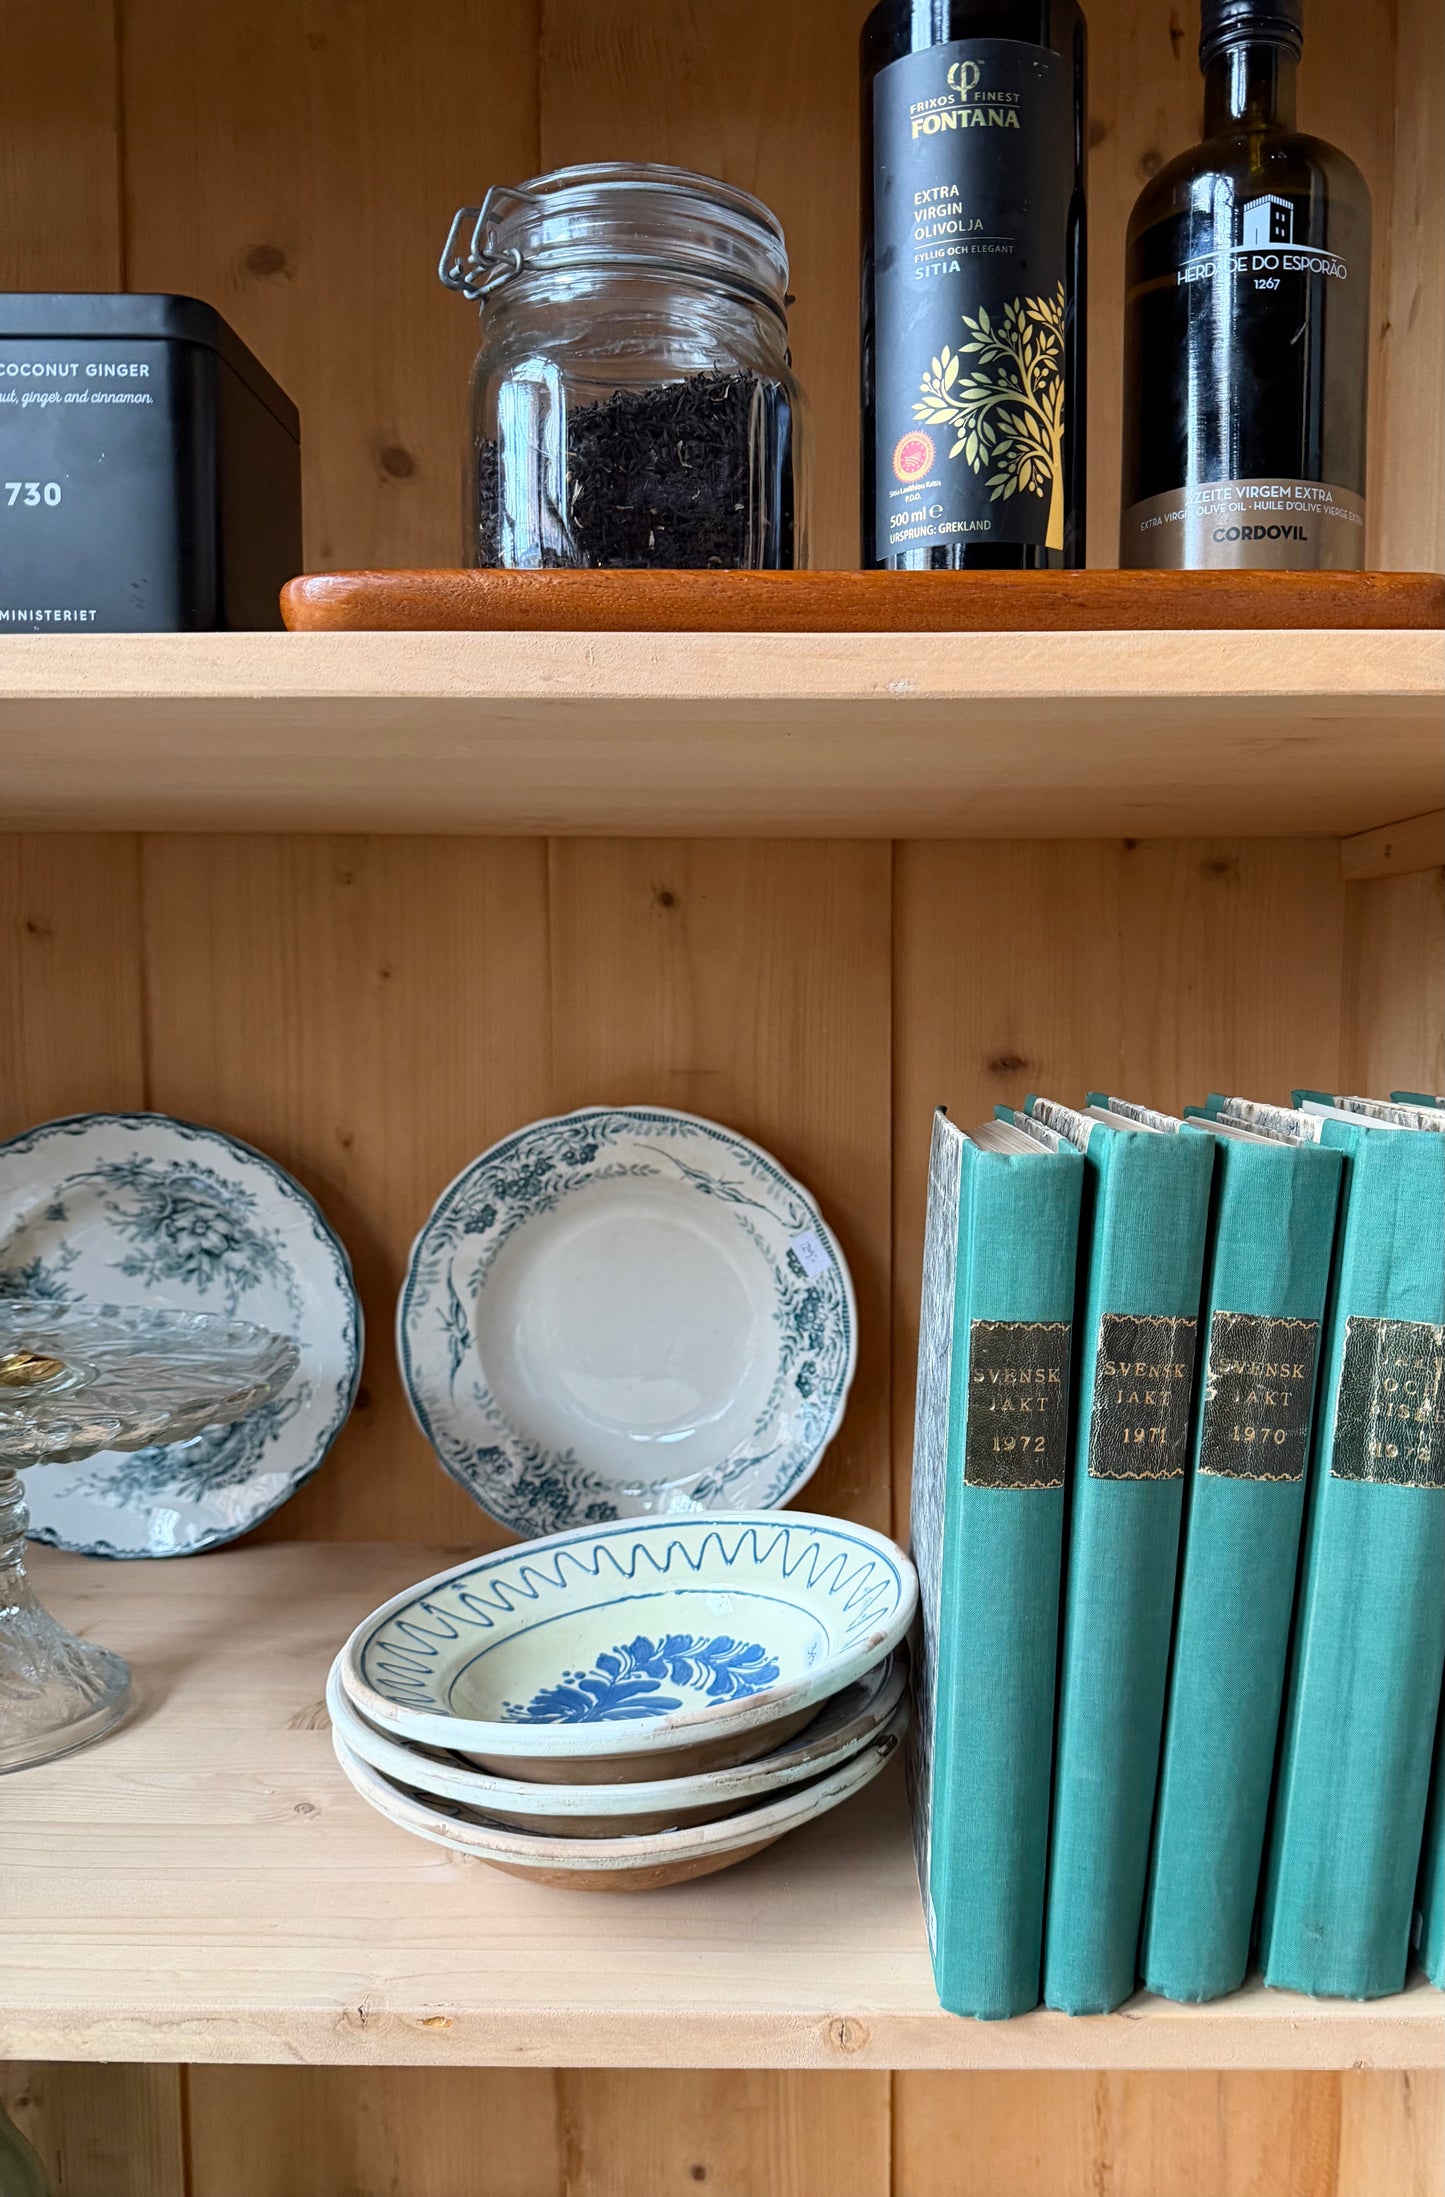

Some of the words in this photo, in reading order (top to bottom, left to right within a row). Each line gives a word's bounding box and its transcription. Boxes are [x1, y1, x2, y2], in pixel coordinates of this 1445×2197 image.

[910, 94, 955, 114] FRIXOS
[974, 91, 1021, 103] FINEST
[911, 108, 1021, 140] FONTANA
[914, 184, 959, 205] EXTRA
[914, 202, 962, 222] VIRGIN
[914, 219, 983, 240] OLIVOLJA
[914, 248, 945, 263] FYLLIG
[947, 246, 968, 255] OCH
[971, 244, 1014, 254] ELEGANT
[915, 260, 961, 280] SITIA
[1252, 254, 1280, 271] DO
[1283, 255, 1348, 280] ESPORÃO
[1254, 277, 1281, 290] 1267
[86, 363, 149, 377] GINGER
[22, 391, 62, 408] ginger
[64, 388, 89, 404] and
[91, 391, 154, 404] cinnamon.
[5, 482, 61, 506] 730
[1185, 488, 1232, 506] AZEITE
[1236, 485, 1291, 499] VIRGEM
[1295, 486, 1333, 502] EXTRA
[890, 511, 909, 529] 500
[911, 505, 926, 522] ml
[1140, 516, 1163, 532] EXTRA
[1196, 503, 1227, 516] OLIVE
[1228, 502, 1246, 512] OIL
[1254, 500, 1284, 511] HUILE
[1286, 501, 1322, 513] D'OLIVE
[889, 524, 937, 545] URSPRUNG:
[938, 520, 991, 534] GREKLAND
[1212, 525, 1308, 543] CORDOVIL
[0, 609, 97, 621] MINISTERIET
[973, 1367, 1061, 1384] SVENSK
[1104, 1360, 1187, 1379] SVENSK
[990, 1396, 1049, 1412] JAKT
[1117, 1390, 1172, 1406] JAKT
[992, 1436, 1046, 1452] 1972
[1122, 1426, 1168, 1444] 1971
[1232, 1424, 1286, 1445] 1970
